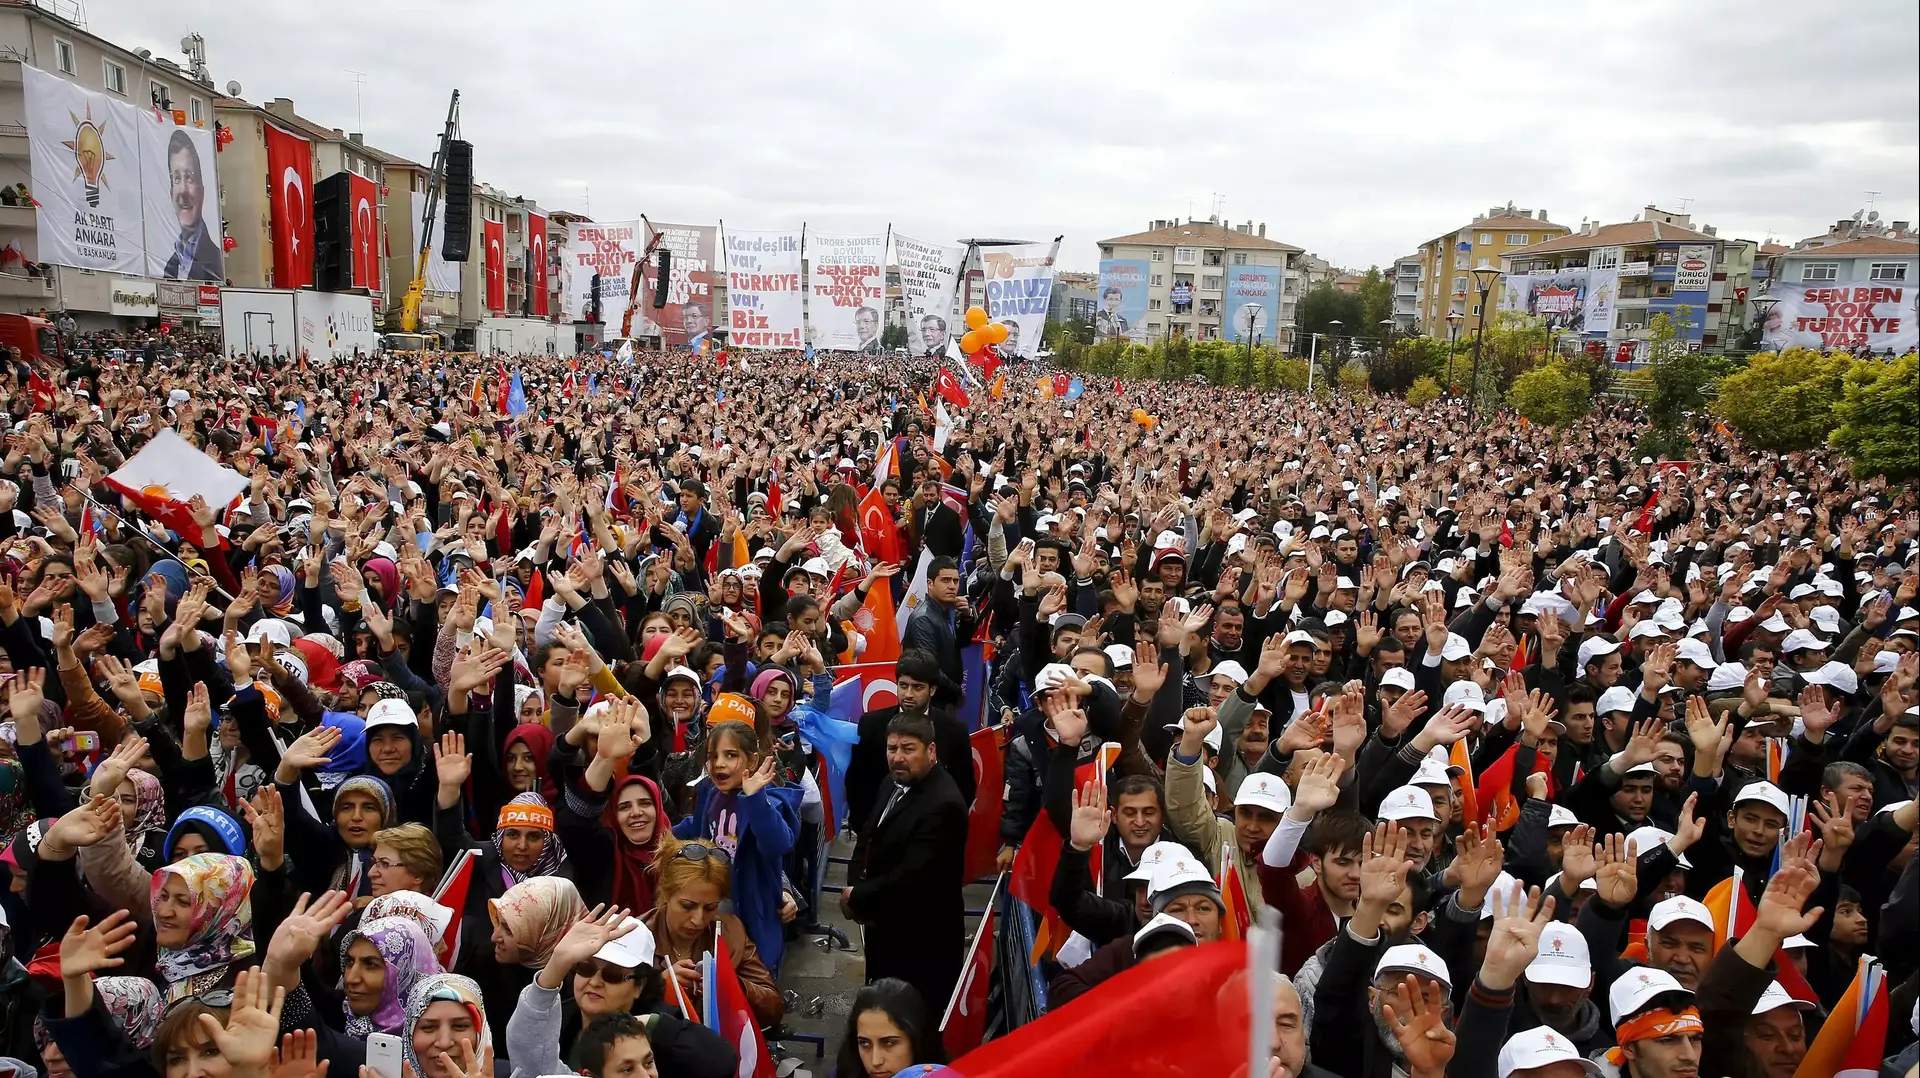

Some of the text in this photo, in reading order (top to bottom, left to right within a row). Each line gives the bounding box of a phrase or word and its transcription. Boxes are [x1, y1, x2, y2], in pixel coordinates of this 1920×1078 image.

[74, 210, 115, 231] AK PARTİ
[75, 228, 116, 248] ANKARA
[578, 228, 633, 241] SEN BEN
[592, 240, 622, 253] YOK
[728, 235, 797, 256] Kardeşlik
[834, 247, 863, 255] BOYUN
[907, 242, 929, 254] VATAN
[577, 251, 635, 266] TÜRKİYE
[677, 257, 707, 272] BEN
[730, 254, 762, 272] var,
[984, 253, 1015, 279] 78
[595, 265, 621, 277] VAR
[669, 269, 691, 281] OK
[817, 265, 879, 276] SEN BEN
[1677, 270, 1708, 278] SÜRÜCÜ
[730, 272, 799, 291] TÜRKİYE
[831, 275, 864, 286] YOK
[814, 285, 881, 298] TÜRKİYE
[988, 278, 1052, 300] OMUZ
[1803, 287, 1903, 303] SEN BEN
[731, 294, 764, 310] var,
[832, 296, 863, 307] VAR
[1824, 302, 1876, 318] YOK
[341, 311, 368, 332] Altus
[732, 309, 769, 329] Biz
[1796, 317, 1901, 333] TÜRKİYE
[731, 328, 801, 347] varız!
[1821, 332, 1869, 348] VAR
[276, 658, 301, 678] ARTİ
[189, 808, 239, 844] PARTİ
[507, 812, 551, 826] PARTİ
